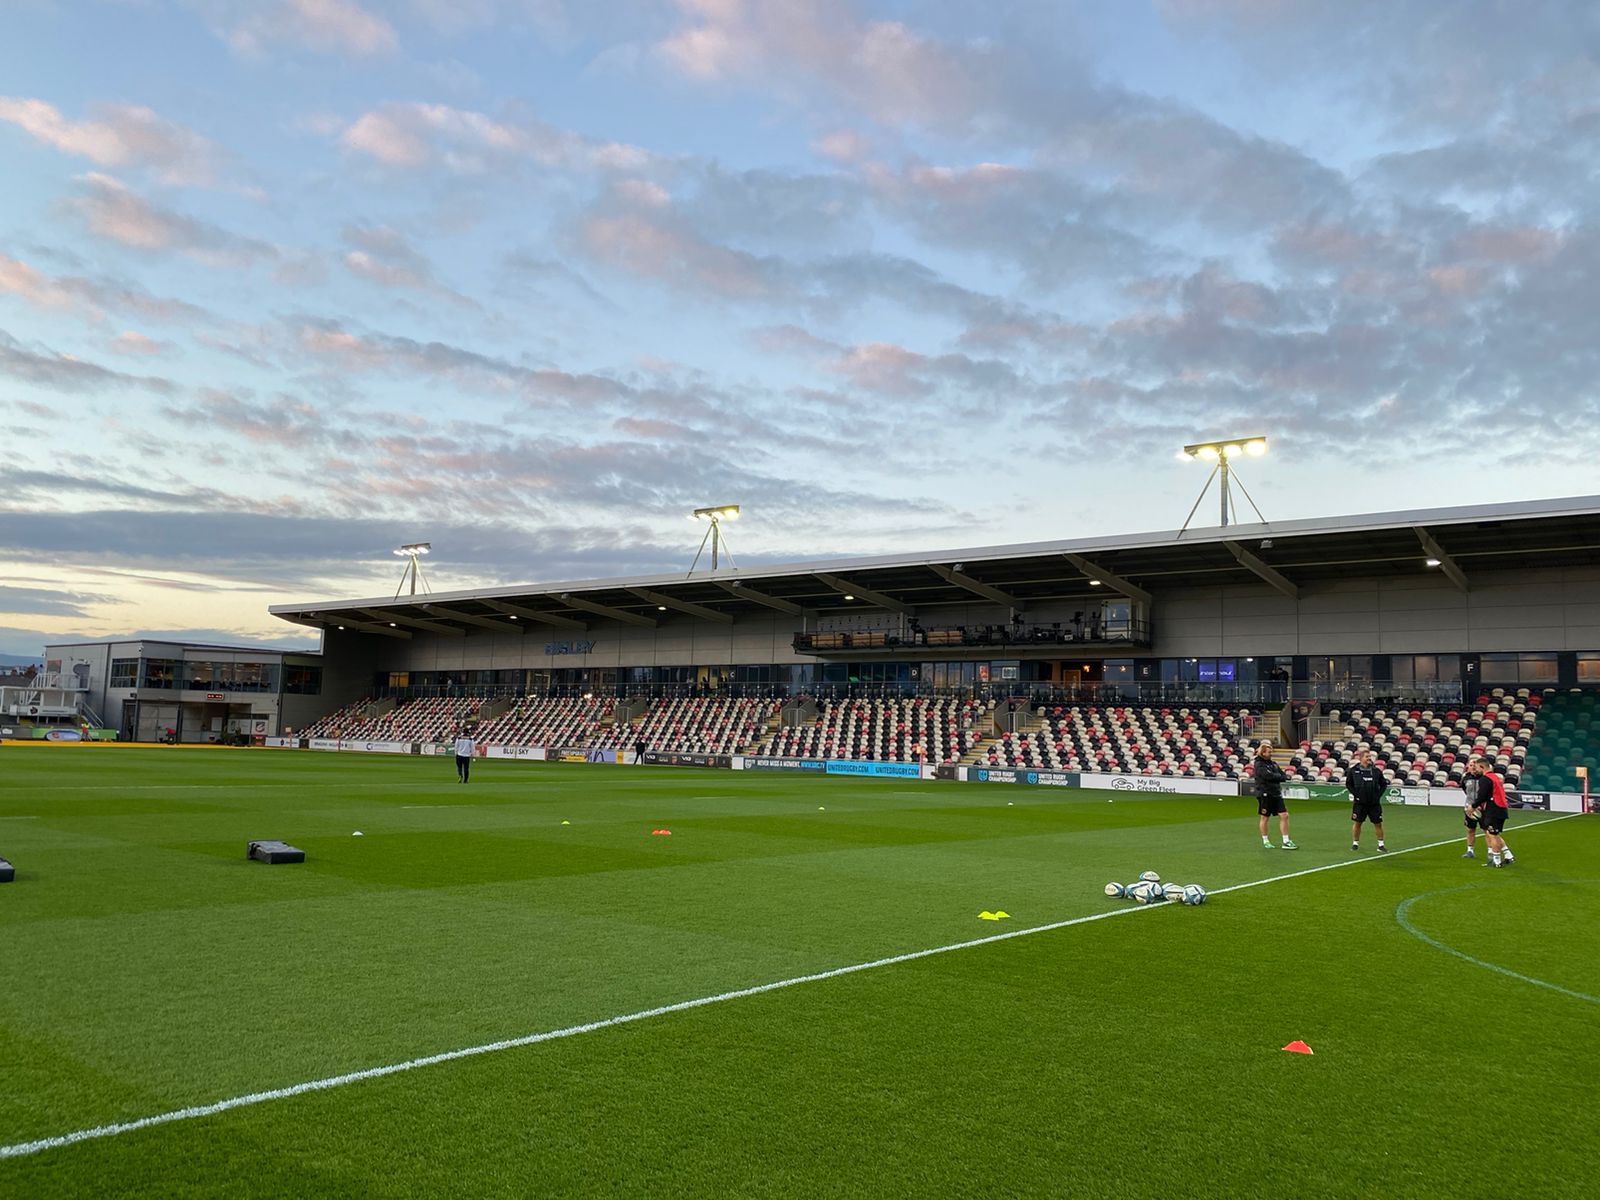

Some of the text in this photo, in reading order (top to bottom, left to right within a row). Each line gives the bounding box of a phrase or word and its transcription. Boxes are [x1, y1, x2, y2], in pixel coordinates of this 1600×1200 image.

[1143, 667, 1149, 675] E
[1467, 663, 1474, 672] F
[911, 669, 918, 677] D
[1136, 779, 1161, 787] My Big
